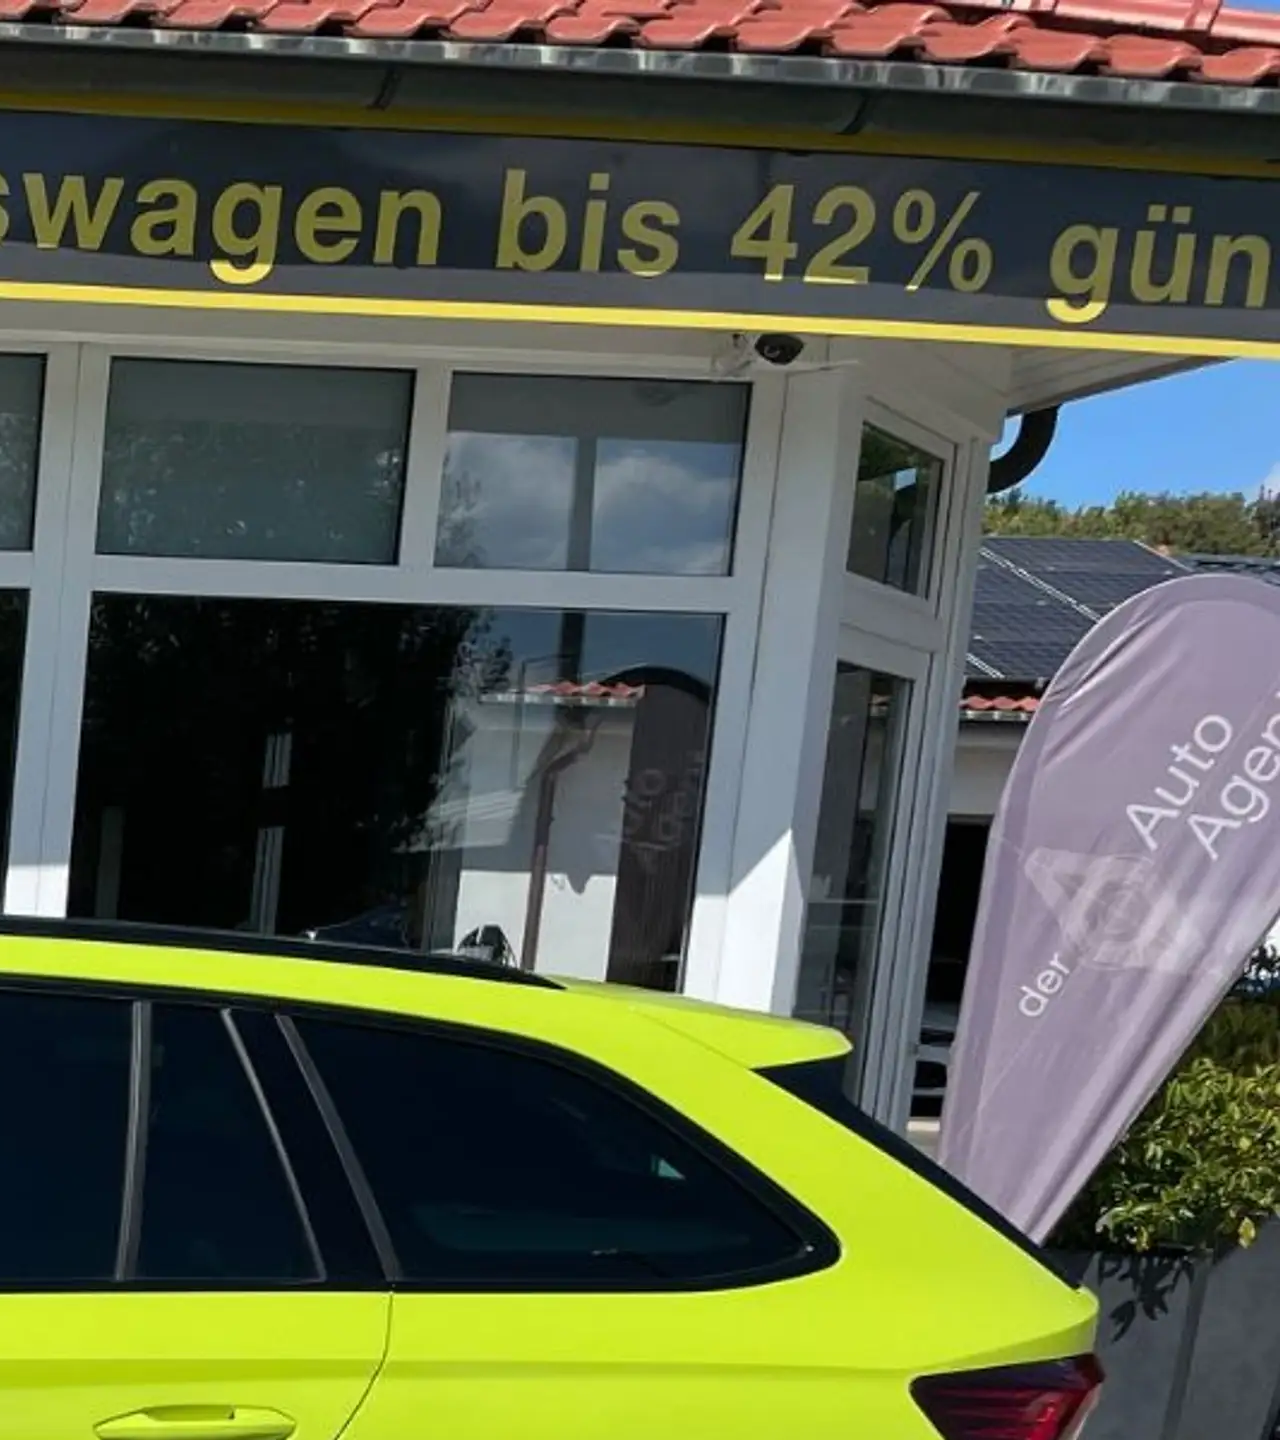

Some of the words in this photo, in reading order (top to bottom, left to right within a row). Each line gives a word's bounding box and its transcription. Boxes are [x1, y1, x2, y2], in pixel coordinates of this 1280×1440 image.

[496, 168, 680, 279] bis
[731, 183, 993, 296] 42%
[1045, 203, 1272, 324] gün
[1126, 714, 1232, 851] Auto
[1187, 690, 1280, 861] Age
[1018, 951, 1071, 1018] der
